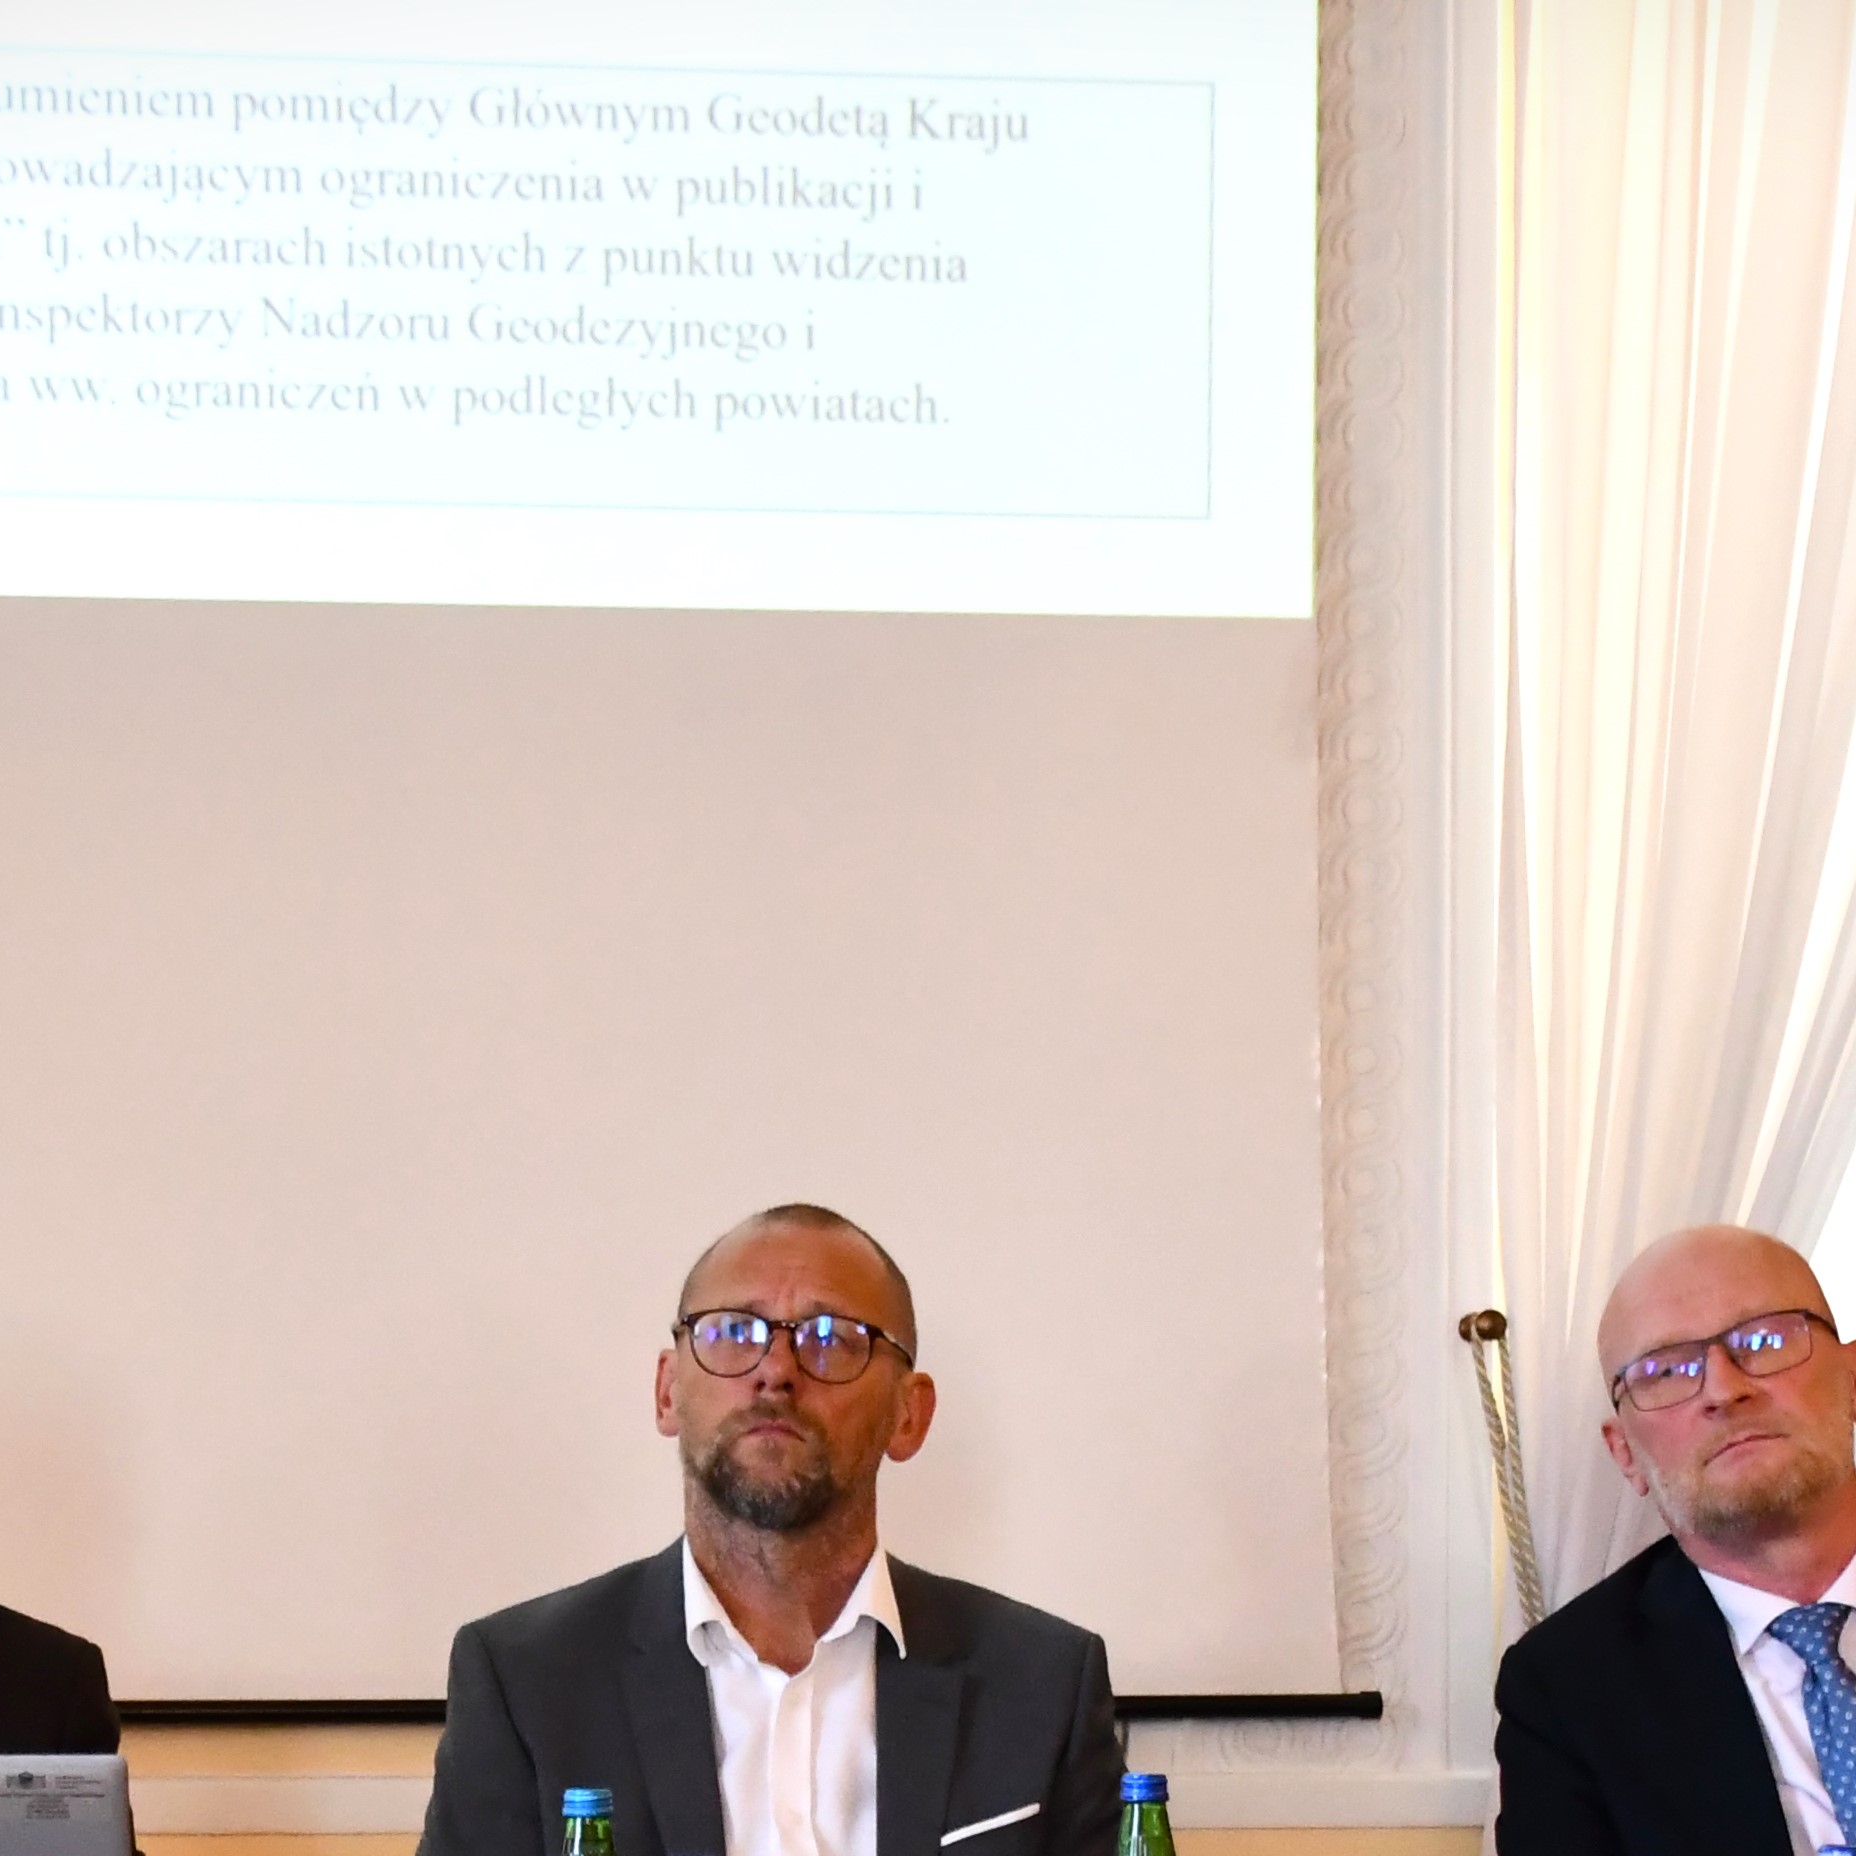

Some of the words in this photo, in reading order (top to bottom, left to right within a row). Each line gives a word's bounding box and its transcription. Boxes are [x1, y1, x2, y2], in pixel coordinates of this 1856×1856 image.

[232, 81, 450, 139] pomiędzy
[469, 86, 690, 144] Głównym
[707, 94, 888, 149] Geodetą
[909, 97, 1029, 155] Kraju
[320, 160, 604, 209] ograniczenia
[622, 175, 658, 201] w
[677, 165, 892, 223] publikacji
[908, 169, 926, 210] i
[44, 226, 82, 273] tj.
[102, 220, 326, 267] obszarach
[347, 226, 545, 284] istotnych
[565, 246, 585, 272] z
[604, 236, 753, 288] punktu
[772, 238, 967, 284] widzenia
[261, 296, 449, 341] Nadzoru
[468, 304, 787, 362] Geodezyjnego
[804, 308, 816, 351] i
[29, 376, 116, 405] ww.
[136, 368, 379, 421] ograniczeń
[399, 385, 434, 411] w
[453, 374, 696, 431] podległych
[715, 380, 950, 433] powiatach.
